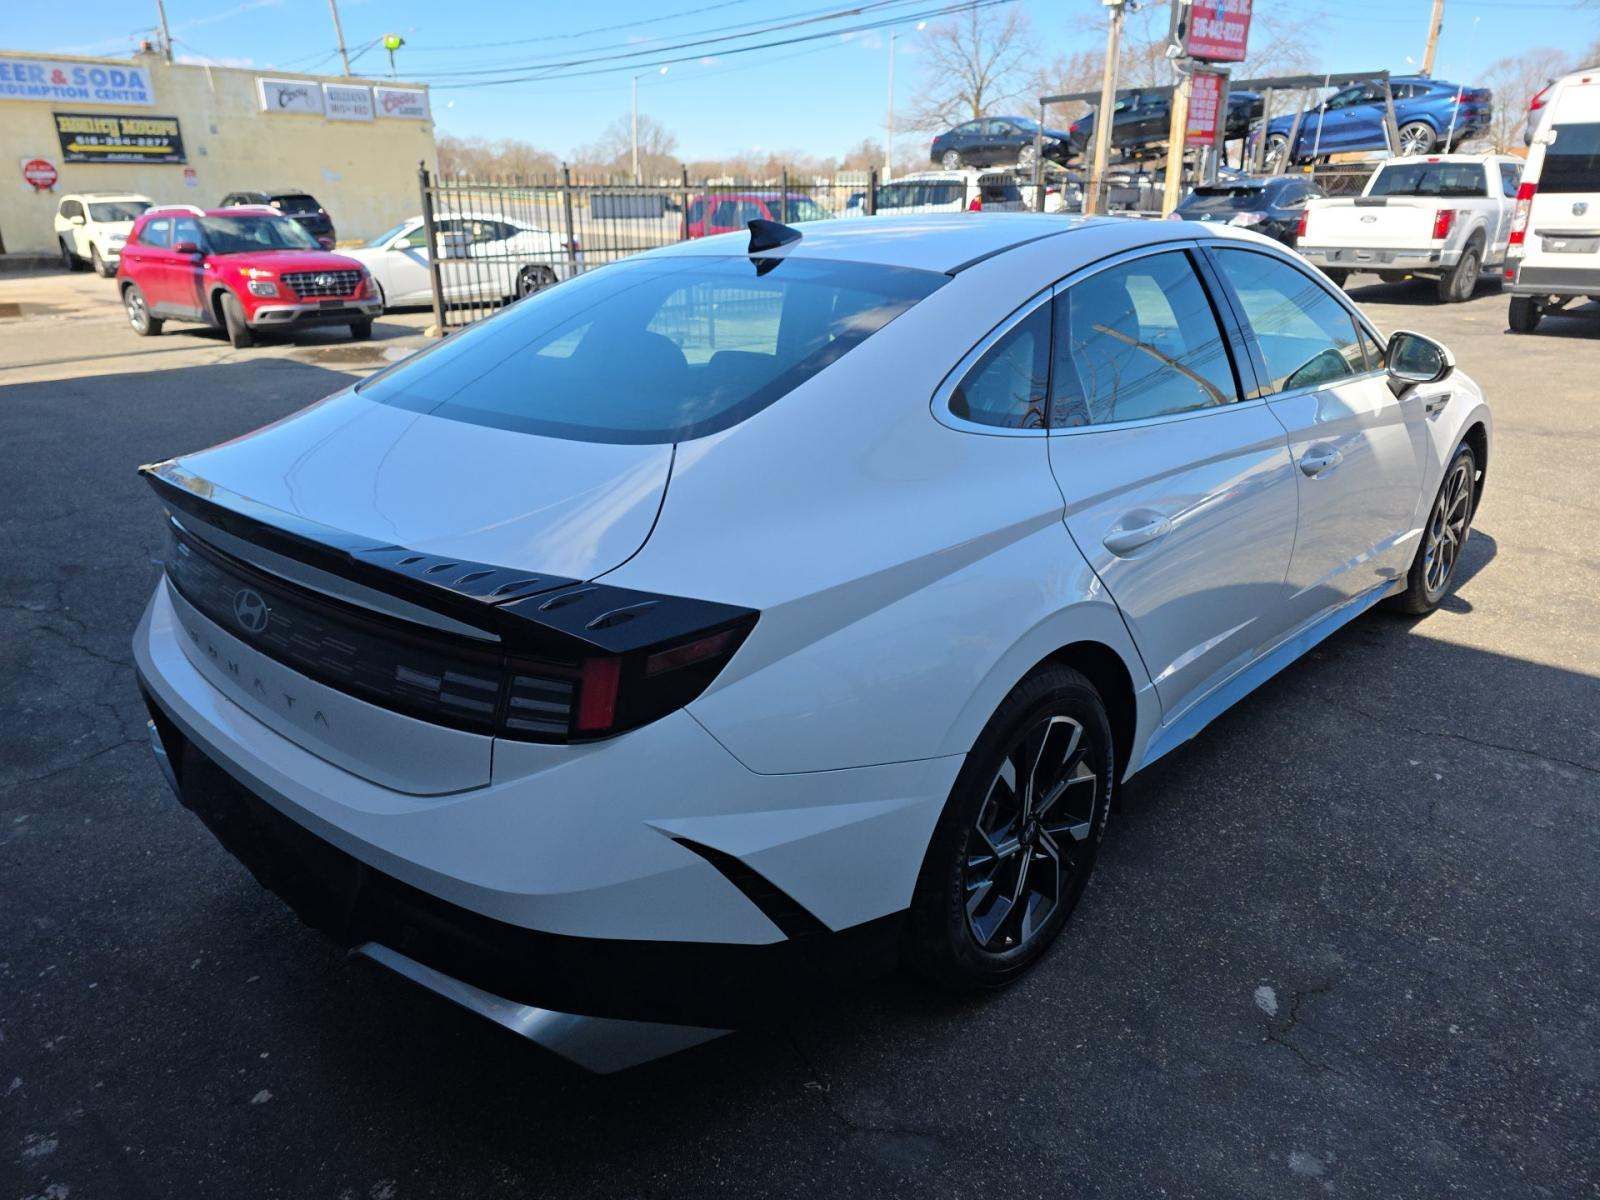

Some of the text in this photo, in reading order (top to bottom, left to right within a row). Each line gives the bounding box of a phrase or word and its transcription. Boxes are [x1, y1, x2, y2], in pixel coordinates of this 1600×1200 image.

[51, 68, 68, 85] &
[72, 67, 145, 88] SODA
[95, 88, 149, 102] CENTER
